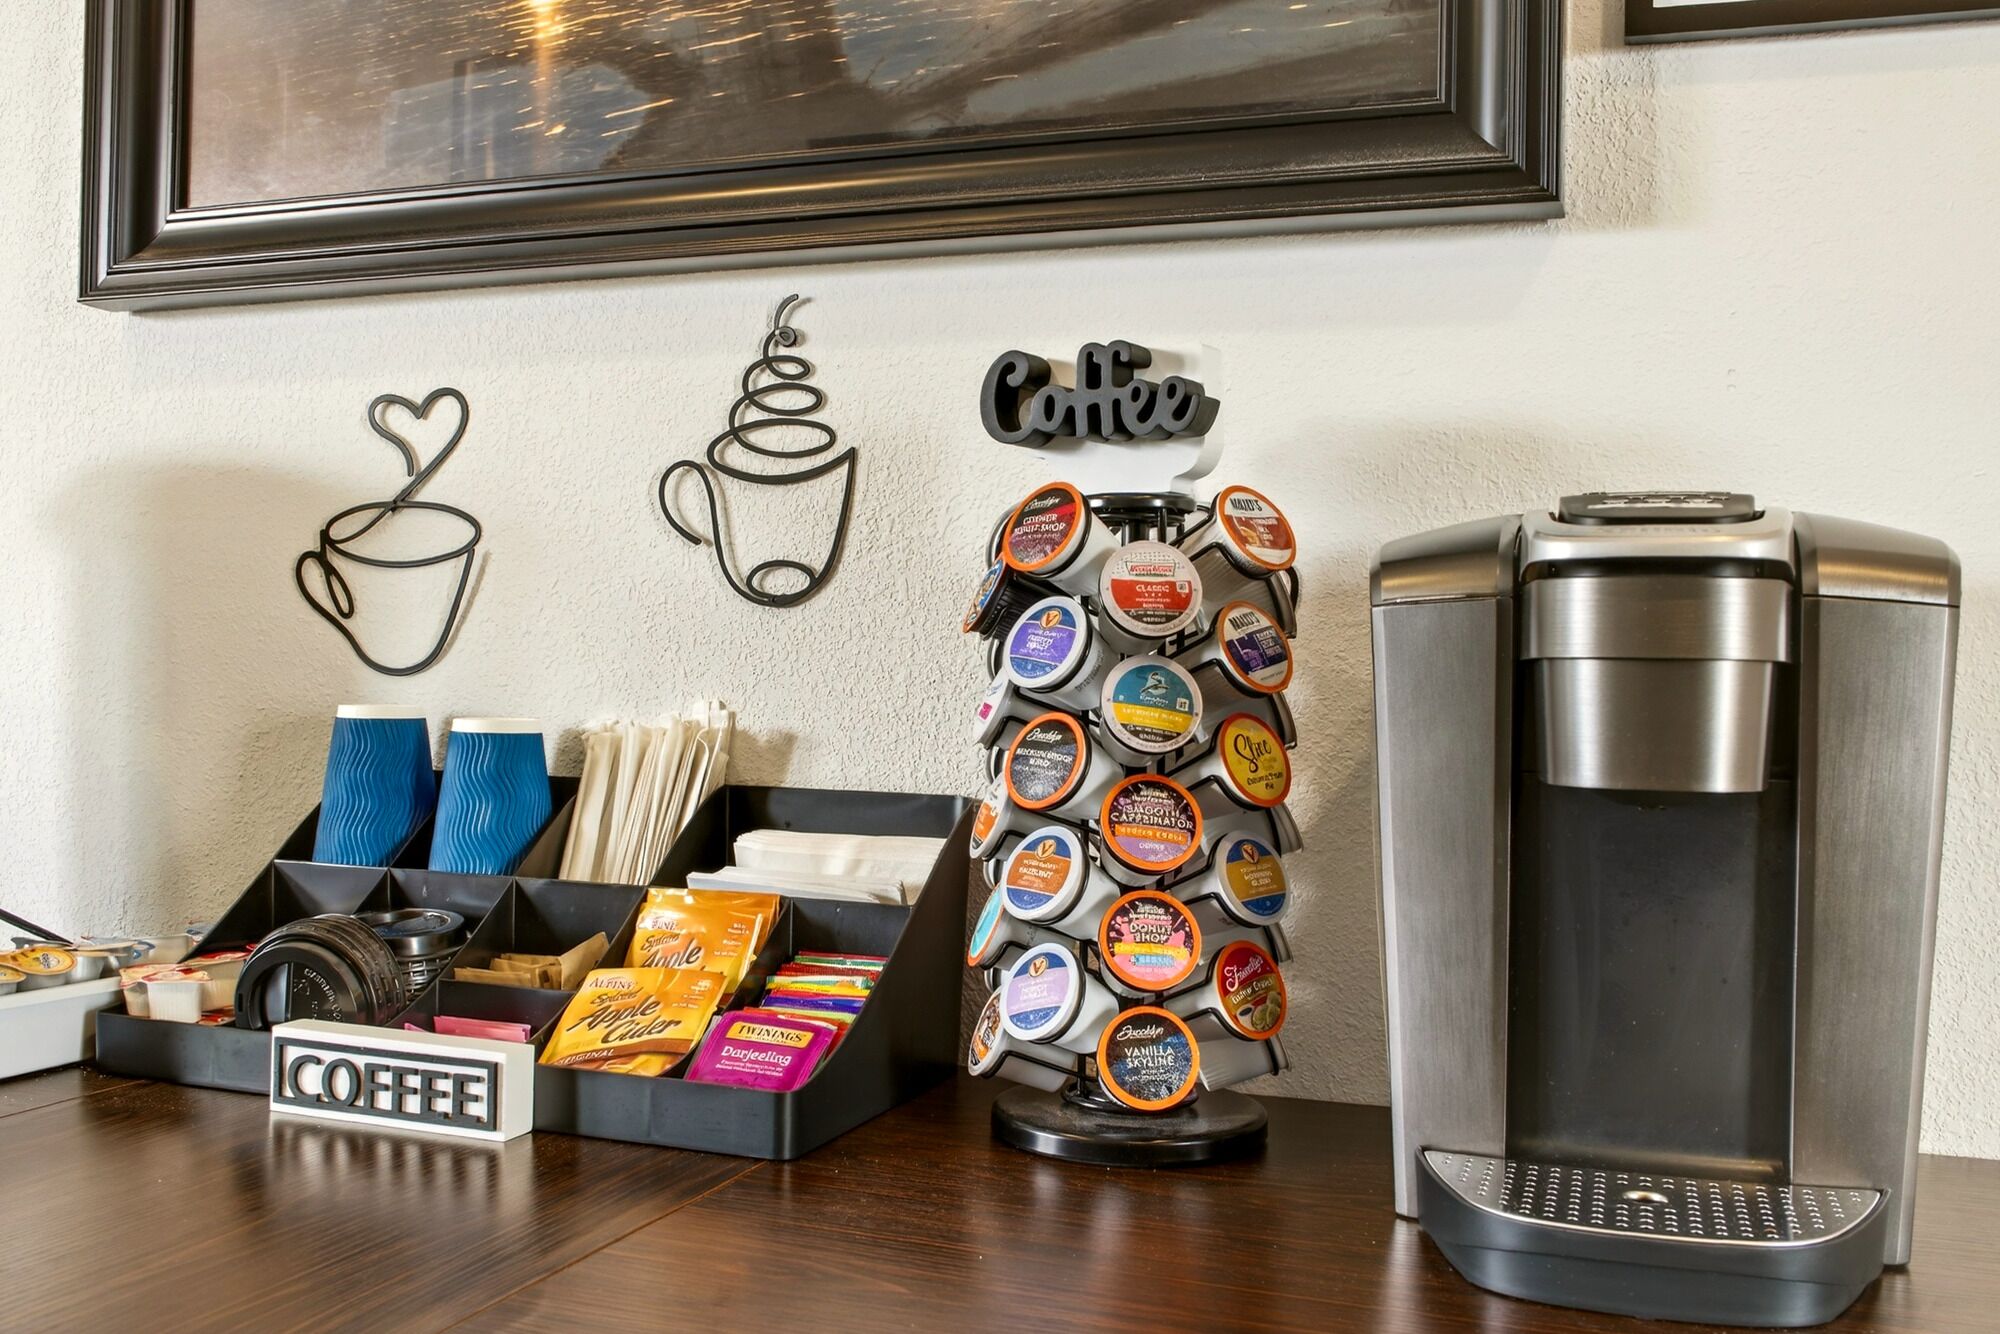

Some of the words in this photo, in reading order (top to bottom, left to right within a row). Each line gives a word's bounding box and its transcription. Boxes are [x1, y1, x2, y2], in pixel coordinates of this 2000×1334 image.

[980, 340, 1220, 449] Coffee
[1135, 584, 1170, 593] CLASSIC
[1129, 923, 1173, 935] DONUT
[566, 995, 661, 1032] Apple
[600, 1020, 682, 1044] Cider
[738, 1024, 803, 1043] TWININGS
[721, 1046, 792, 1067] Darjeeling
[1124, 1045, 1176, 1057] VANILLA
[1126, 1055, 1176, 1069] SKYLINE
[287, 1054, 486, 1124] COFFEE
